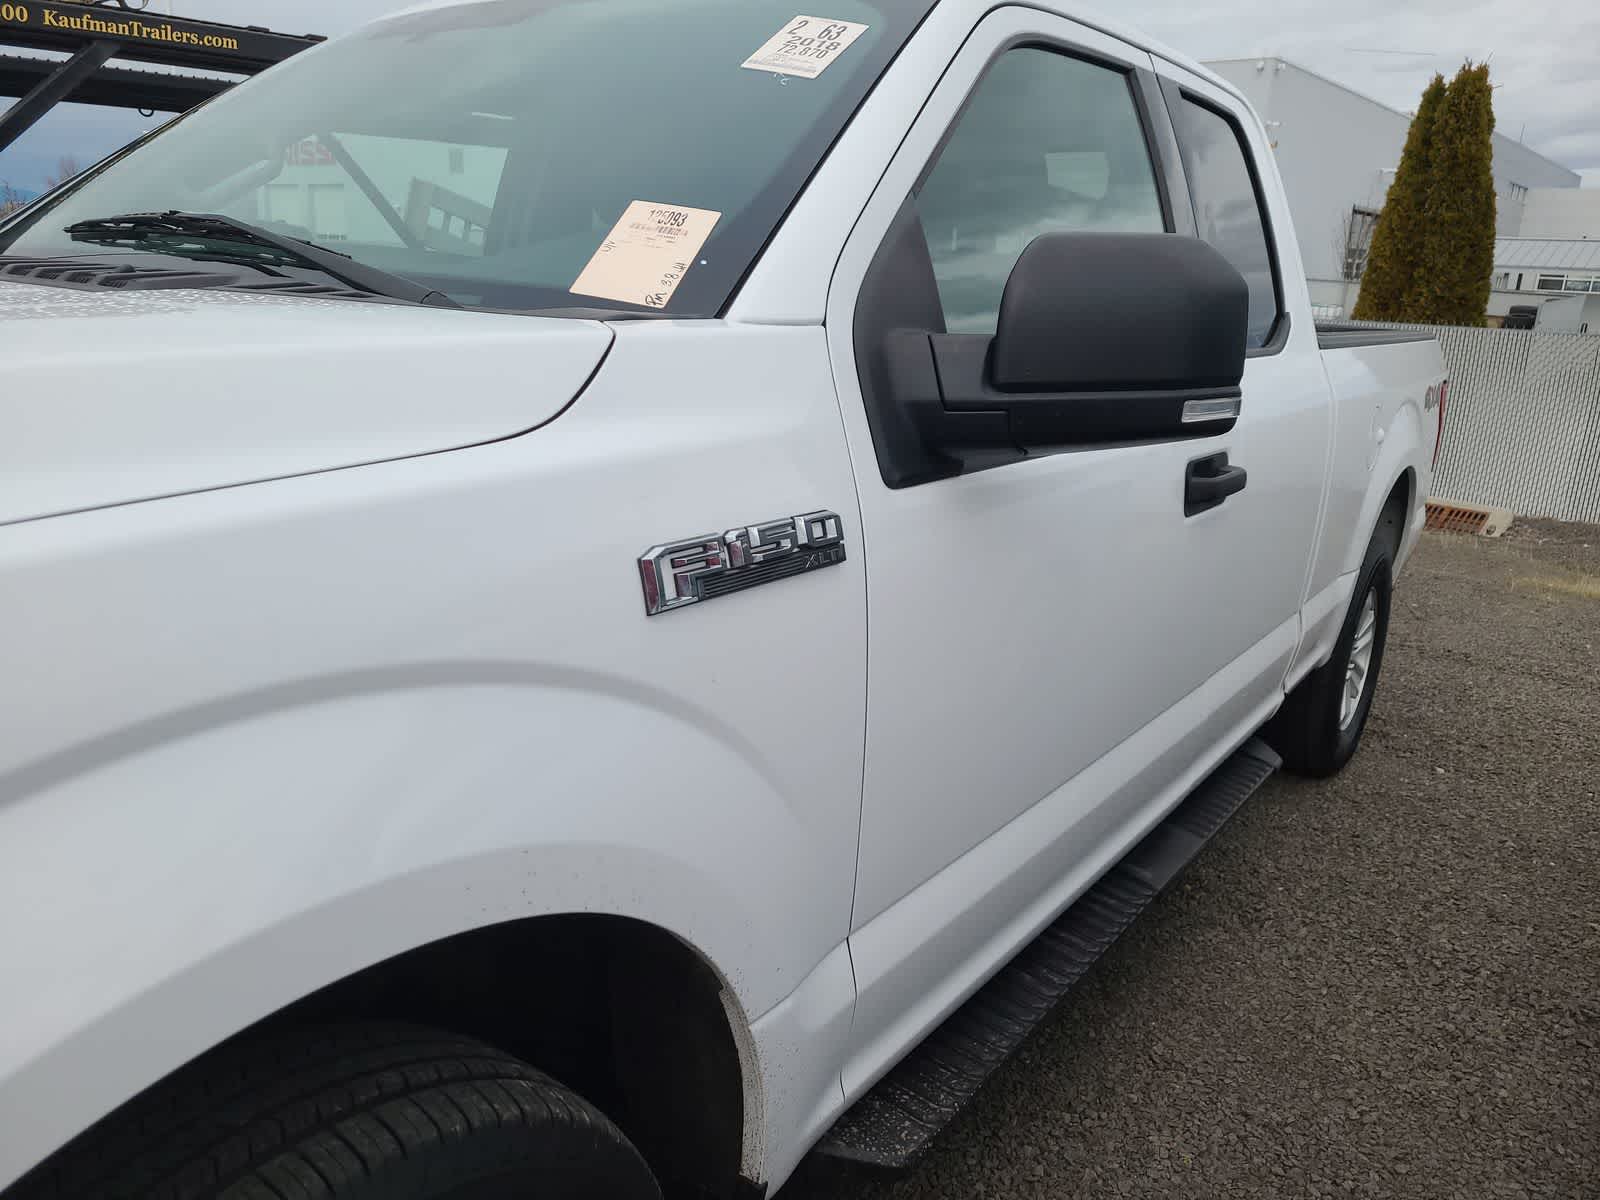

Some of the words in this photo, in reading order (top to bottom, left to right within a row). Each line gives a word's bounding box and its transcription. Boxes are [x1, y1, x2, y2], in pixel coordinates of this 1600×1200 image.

[0, 3, 29, 23] 00
[43, 9, 239, 50] KaufmanTrailers.com
[787, 20, 809, 35] 2
[817, 23, 848, 41] 63
[786, 35, 841, 51] 2018
[805, 548, 841, 569] XLT
